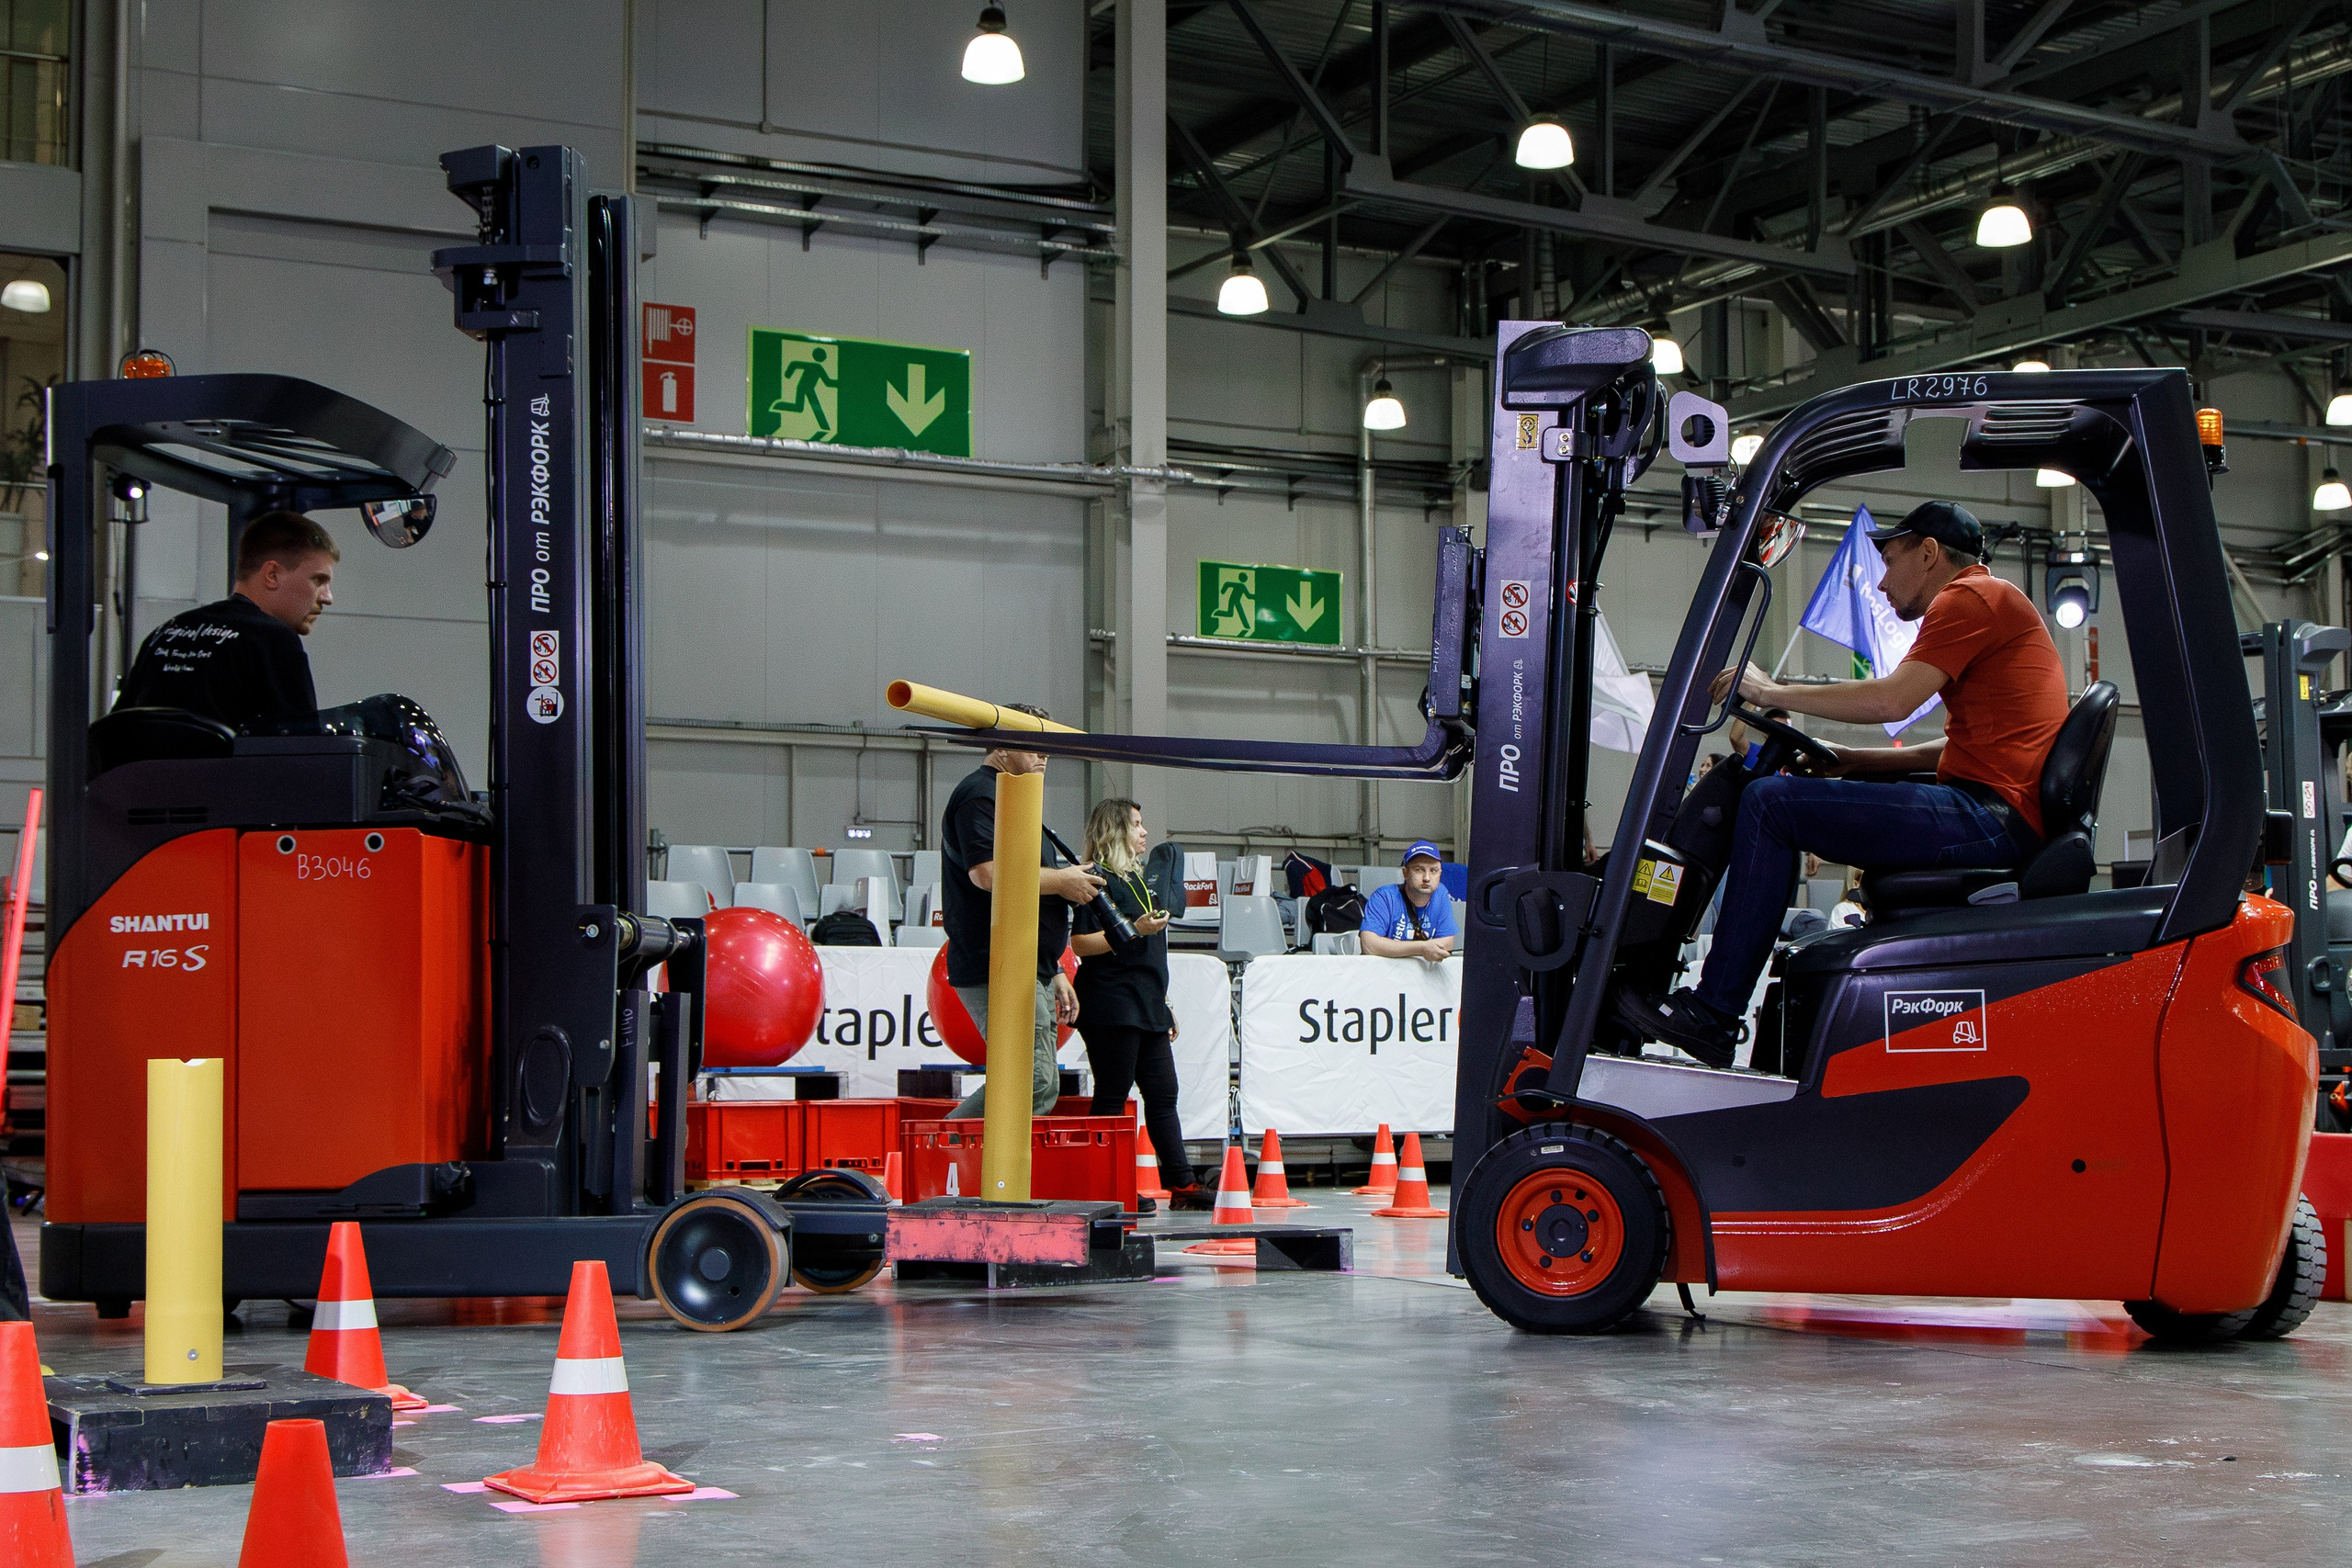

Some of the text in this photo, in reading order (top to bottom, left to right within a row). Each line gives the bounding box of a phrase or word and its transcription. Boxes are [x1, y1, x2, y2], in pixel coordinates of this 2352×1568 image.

[1891, 376, 1988, 400] LR2976
[530, 420, 550, 525] РЭКФОРК
[530, 568, 550, 614] ПРО
[1498, 743, 1521, 793] ПРО
[1511, 671, 1524, 722] РЭКФОРК
[297, 853, 372, 881] B3046
[1183, 882, 1214, 891] RackFork
[2308, 879, 2319, 910] ПРО
[109, 912, 210, 934] SHANTUI
[1298, 993, 1453, 1055] Stapler
[1891, 998, 1964, 1017] РэкФорк
[816, 994, 944, 1060] taple
[945, 1162, 960, 1197] 4
